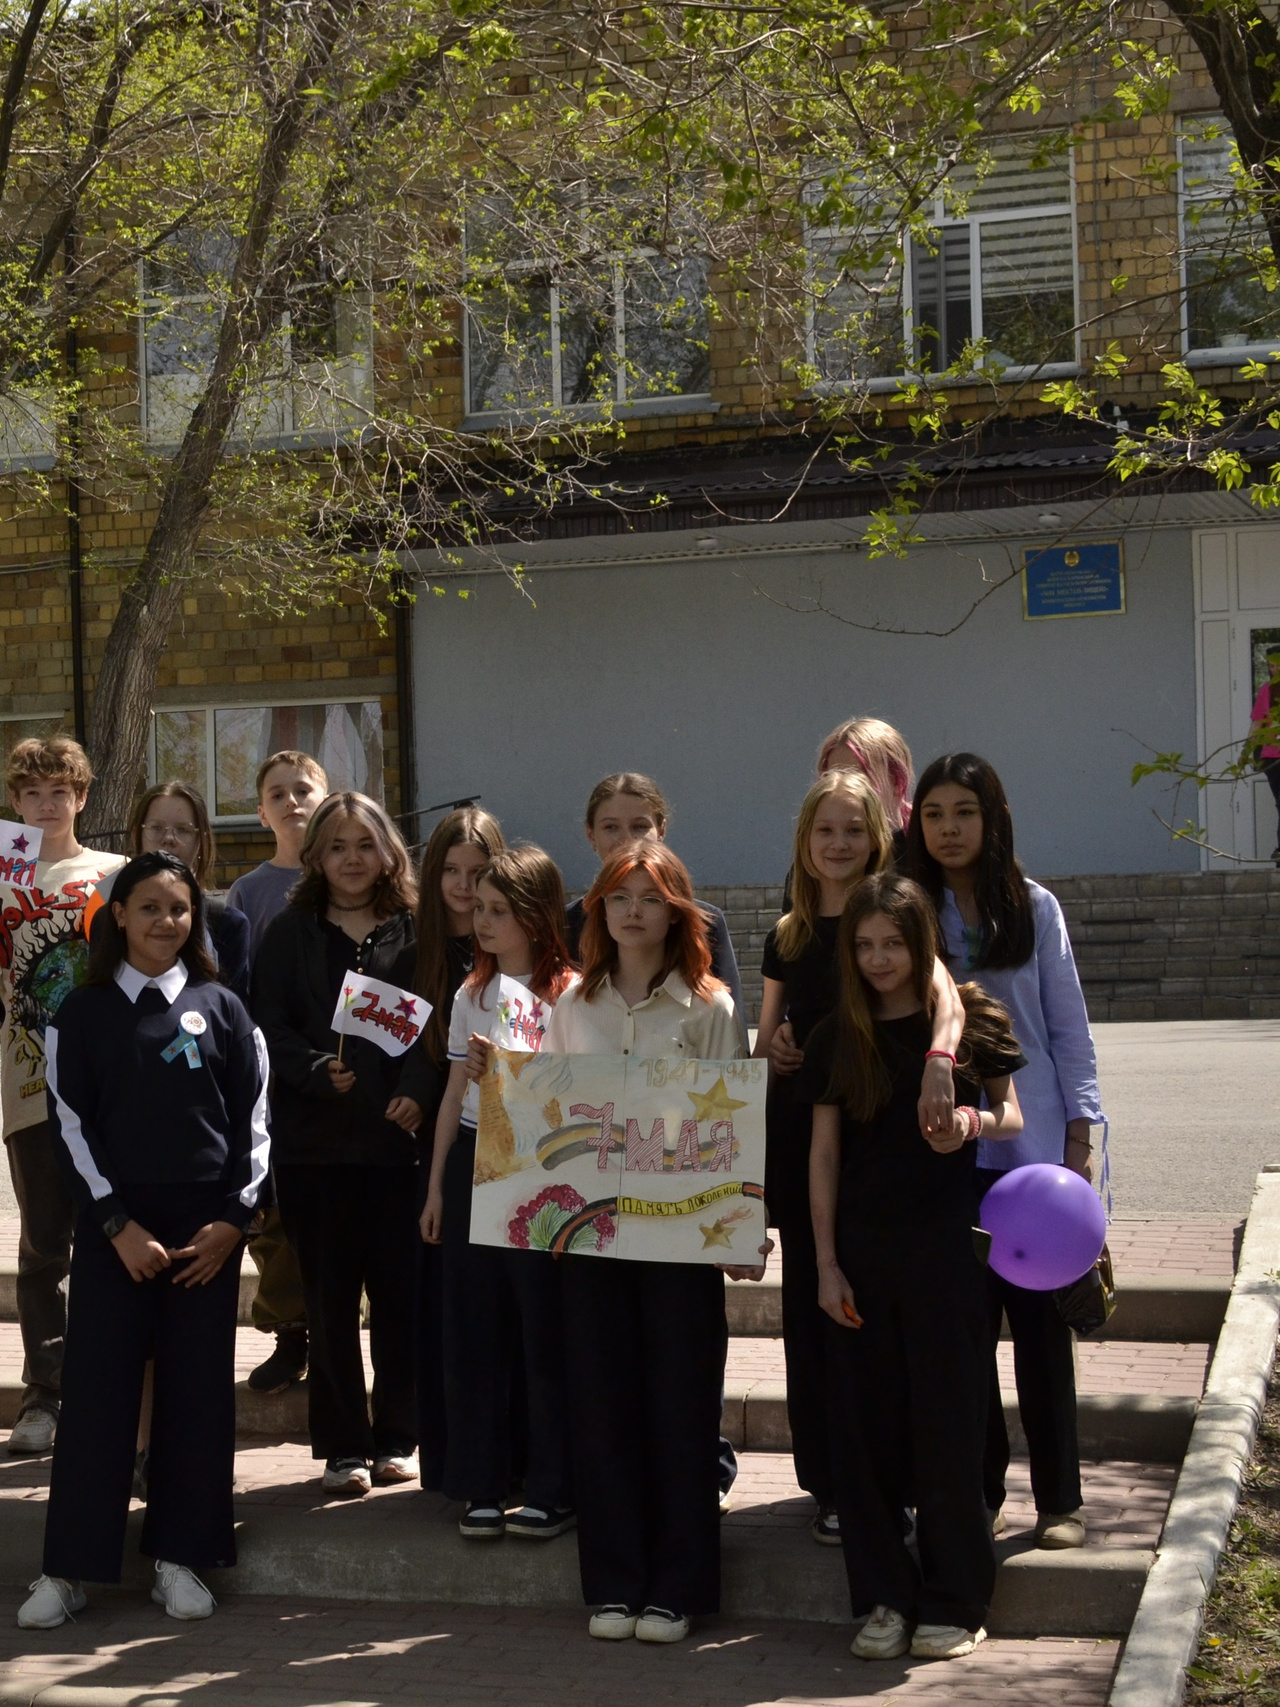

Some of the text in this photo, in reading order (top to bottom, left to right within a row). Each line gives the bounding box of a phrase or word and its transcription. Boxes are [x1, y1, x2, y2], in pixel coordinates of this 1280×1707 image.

[359, 990, 381, 1023] 7
[20, 1078, 47, 1099] HEA
[570, 1102, 615, 1170] 7
[625, 1117, 734, 1172] МАЯ
[622, 1197, 682, 1216] ПАМЯТЬ
